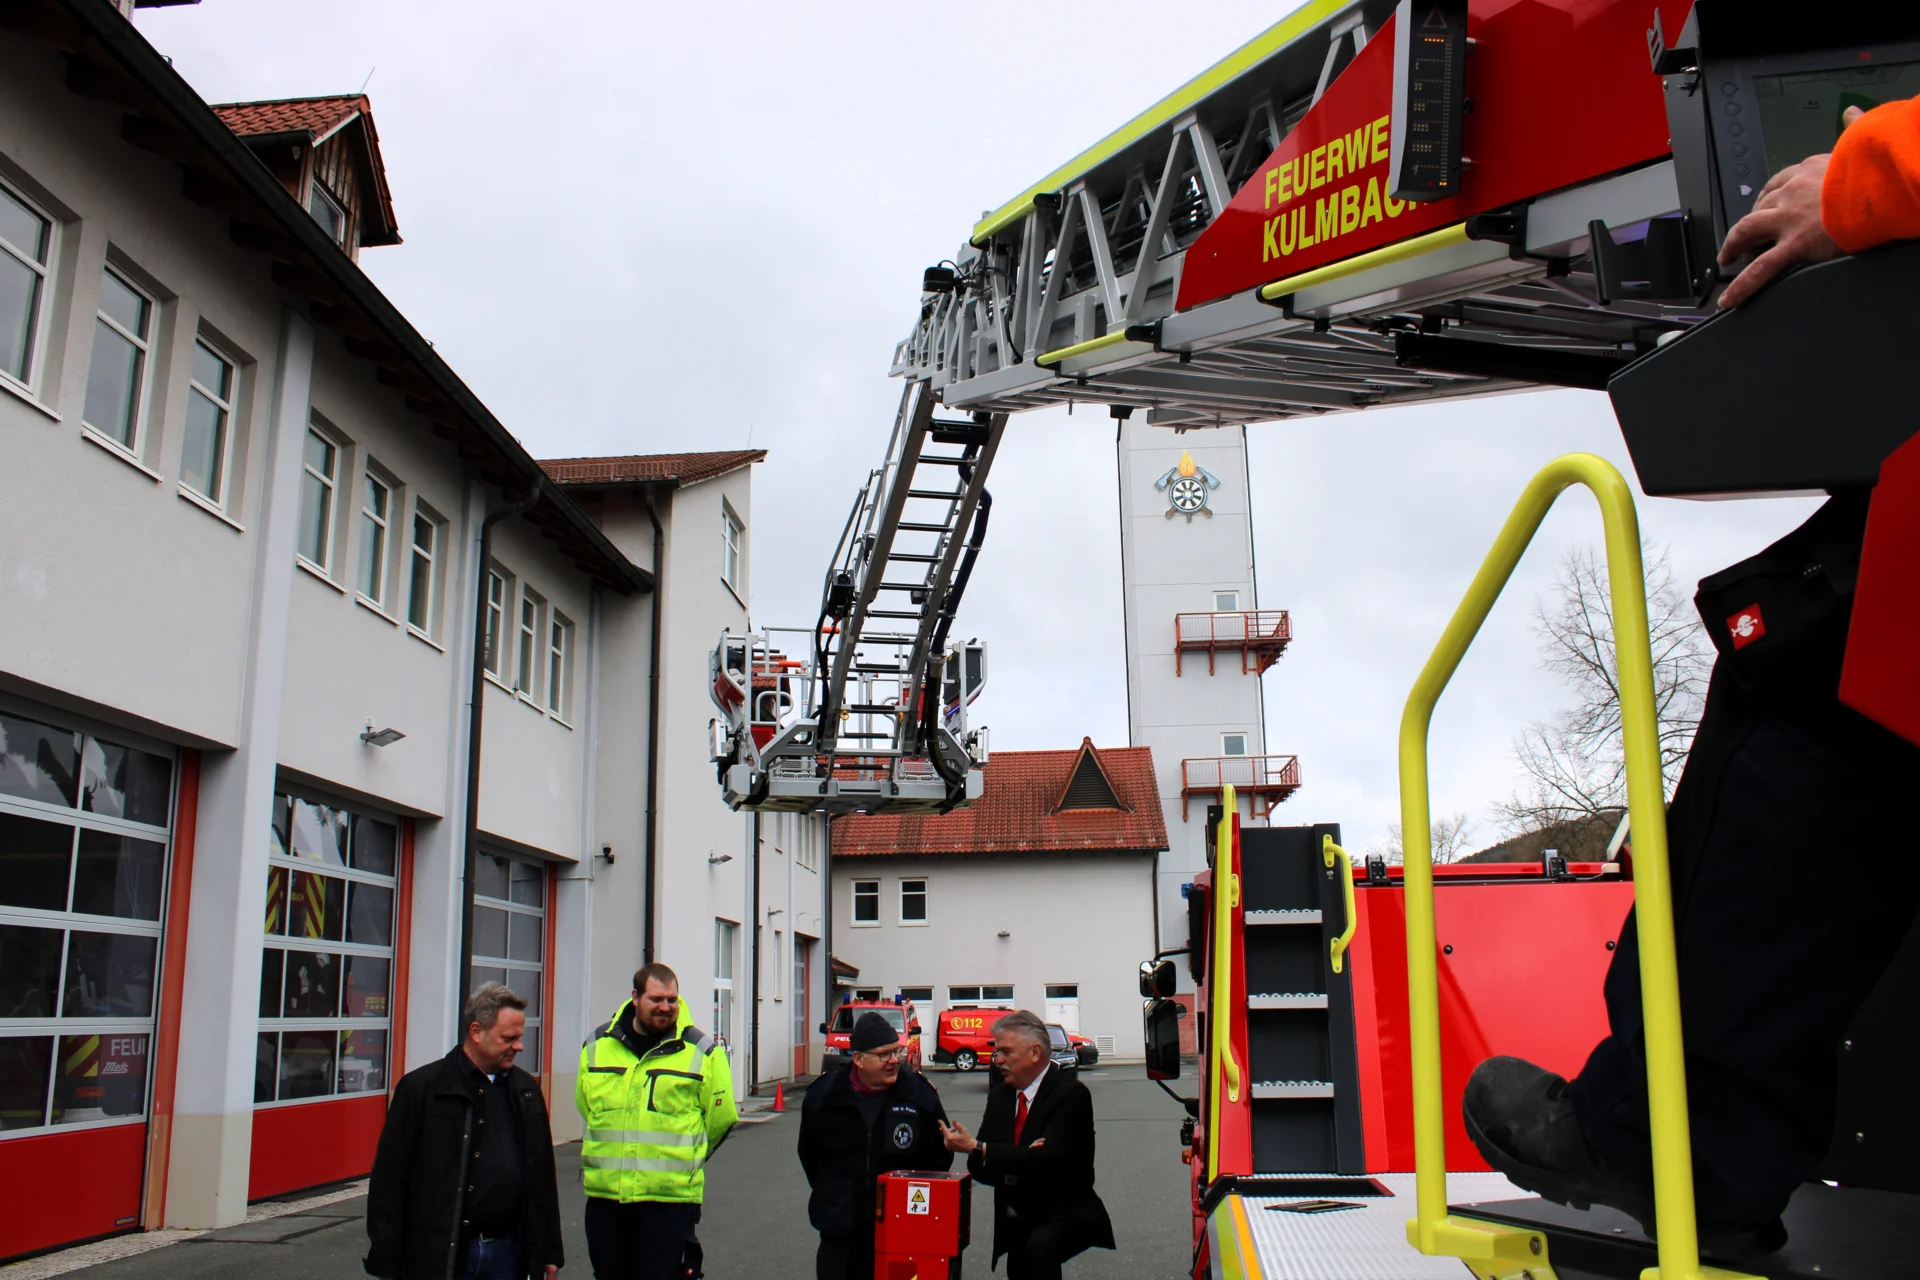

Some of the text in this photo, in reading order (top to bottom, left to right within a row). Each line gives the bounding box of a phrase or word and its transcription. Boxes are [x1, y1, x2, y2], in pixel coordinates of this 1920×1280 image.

[1262, 175, 1429, 263] KULMBAC
[964, 1017, 983, 1029] 112
[101, 1061, 129, 1075] Metz
